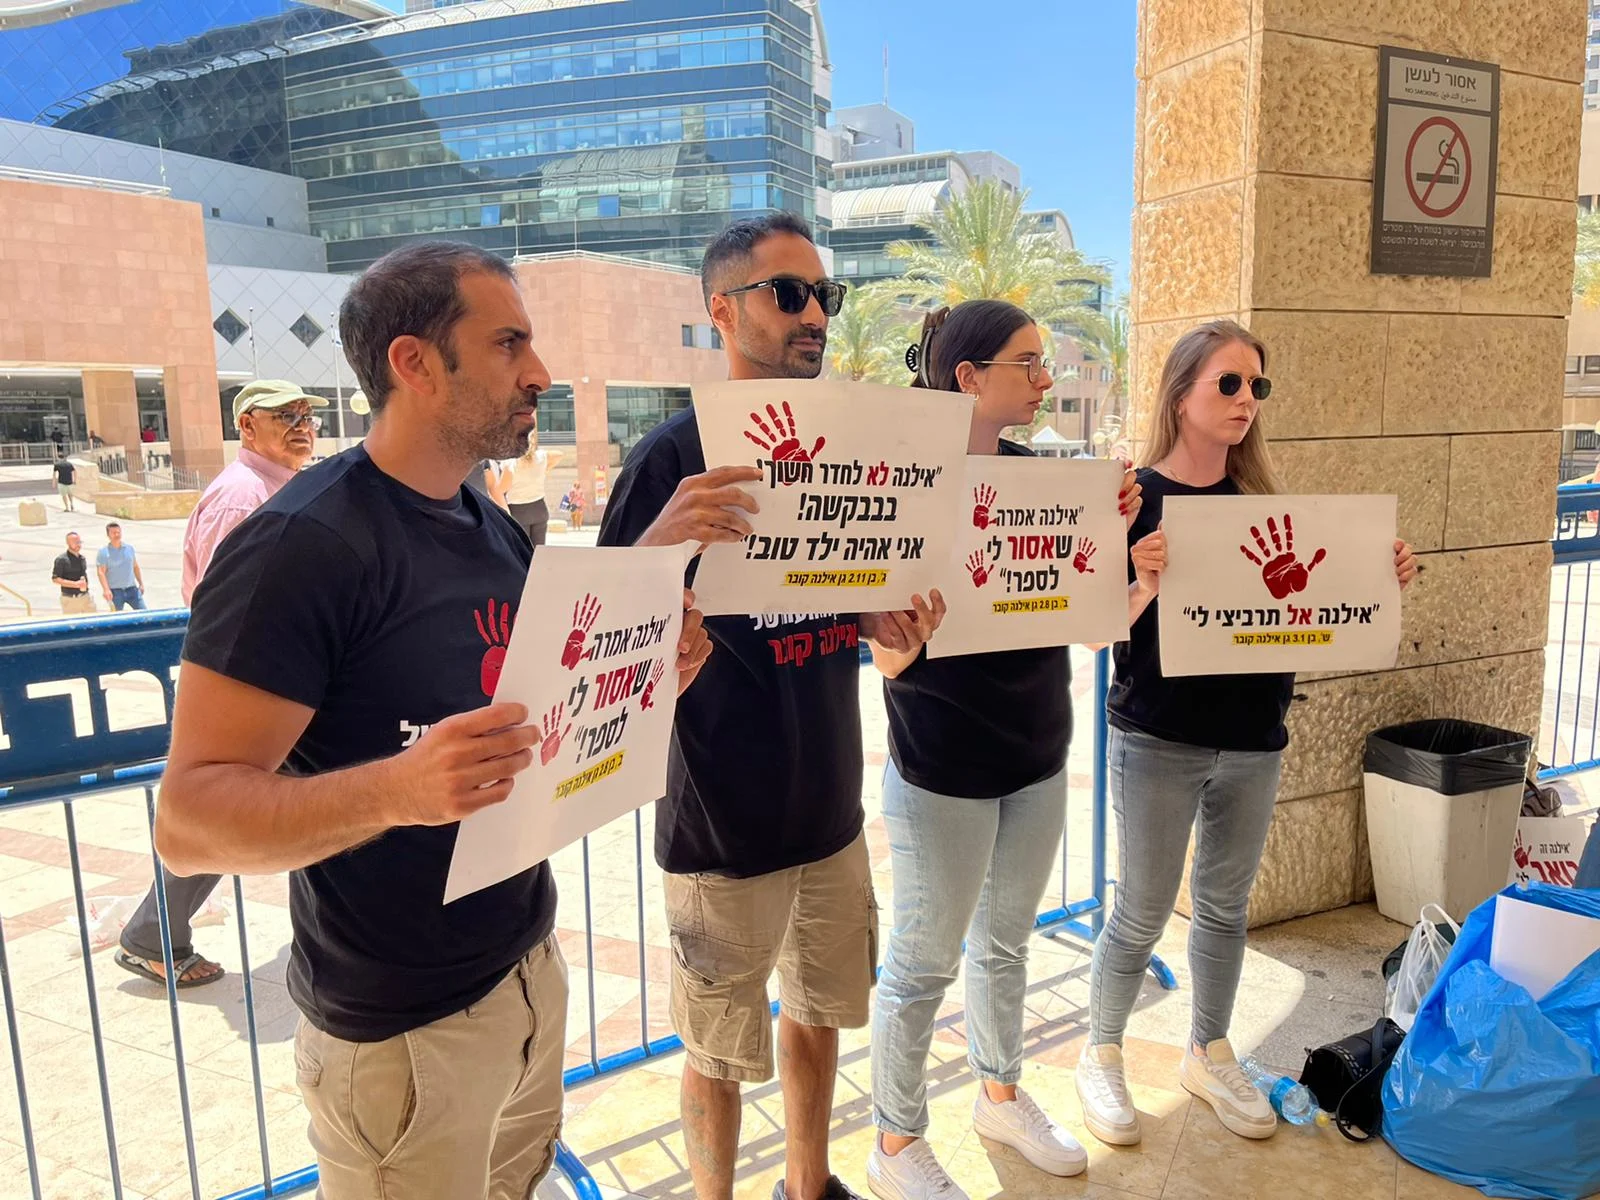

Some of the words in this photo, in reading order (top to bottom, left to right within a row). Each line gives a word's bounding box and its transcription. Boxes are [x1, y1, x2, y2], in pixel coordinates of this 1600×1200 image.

[1405, 66, 1441, 84] לעשן
[1445, 72, 1477, 90] אסור
[1415, 88, 1439, 99] SMOKING
[756, 458, 814, 489] חשוך!
[819, 459, 863, 485] לחדר
[866, 461, 889, 486] לא
[891, 462, 943, 488] "אילנה
[797, 492, 898, 529] בבבקשה!
[996, 508, 1036, 527] אמרה
[1040, 504, 1084, 526] "אילנה
[806, 531, 840, 561] ילד
[843, 536, 892, 560] אהיה
[896, 536, 925, 560] אני
[986, 535, 1002, 561] לי
[1007, 534, 1073, 561] שאסור
[787, 573, 810, 587] קובר
[811, 571, 837, 584] אילנה
[837, 573, 847, 586] גן
[848, 572, 866, 583] 2.11
[867, 573, 877, 586] בן
[992, 603, 1009, 614] קובר
[1010, 600, 1030, 611] אילנה
[1031, 600, 1038, 612] גן
[1040, 599, 1050, 609] 2.8
[1051, 599, 1058, 610] בן
[1318, 602, 1380, 625] "אילנה
[1183, 605, 1209, 628] לי"
[1215, 607, 1281, 627] תרביצי
[1287, 604, 1312, 625] אל
[588, 627, 632, 662] אמרה
[818, 622, 858, 656] אילנה
[1233, 635, 1254, 646] קובר
[1256, 632, 1281, 644] אילנה
[1282, 634, 1291, 645] גן
[1292, 633, 1305, 643] 3.1
[1307, 633, 1316, 644] בן
[593, 658, 653, 711] שאסור
[567, 676, 590, 718] לי
[1539, 843, 1548, 854] זה
